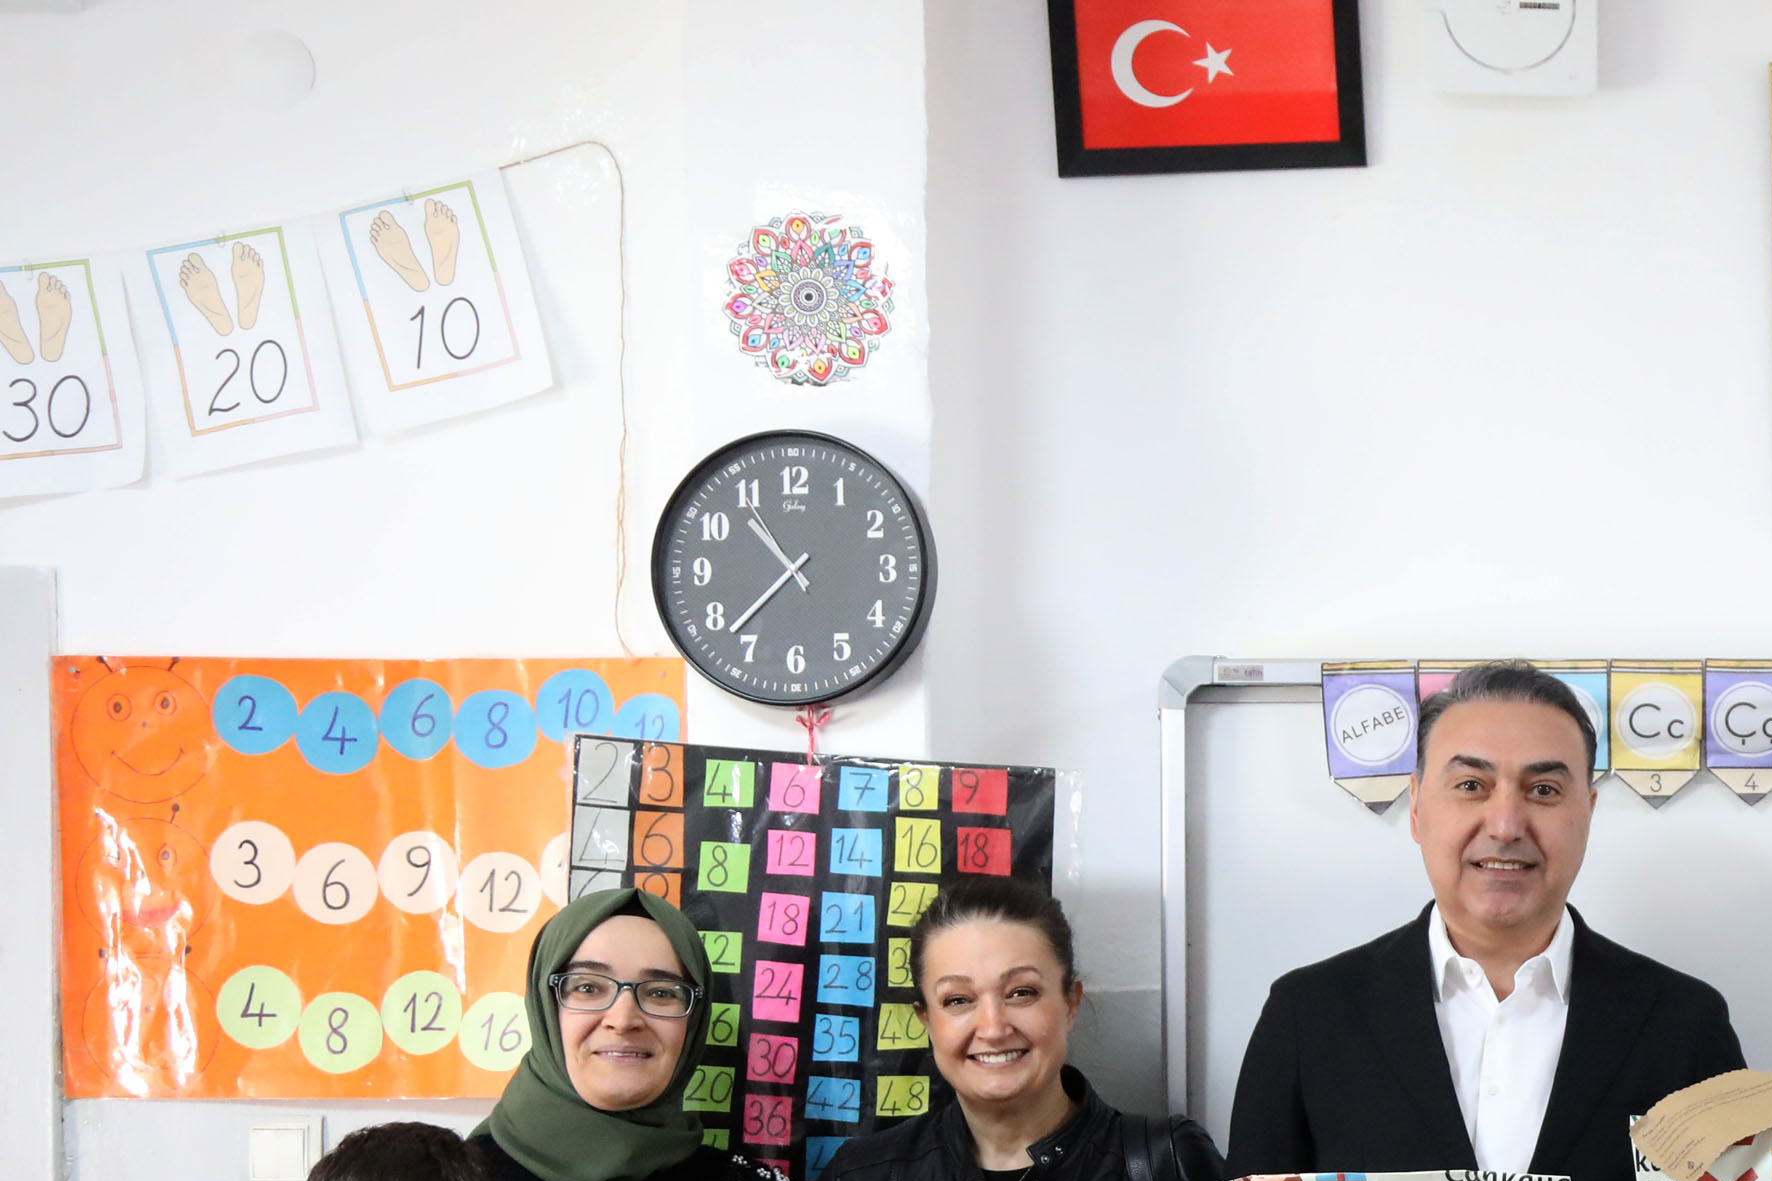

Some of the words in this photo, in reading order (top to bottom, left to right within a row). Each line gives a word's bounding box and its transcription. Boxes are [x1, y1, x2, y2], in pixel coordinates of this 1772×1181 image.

[408, 296, 480, 370] 10
[208, 339, 288, 416] 20
[2, 374, 91, 442] 30
[736, 479, 760, 508] 11
[780, 466, 809, 495] 12
[833, 478, 845, 506] 1
[700, 512, 730, 541] 10
[867, 510, 884, 538] 2
[693, 557, 712, 586] 9
[879, 554, 897, 583] 3
[705, 602, 725, 630] 8
[867, 600, 885, 627] 4
[740, 634, 758, 662] 7
[786, 645, 805, 673] 6
[833, 633, 851, 660] 5
[238, 695, 263, 733] 2
[322, 706, 358, 755] 4
[411, 693, 436, 738] 6
[485, 702, 509, 750] 8
[557, 687, 600, 729] 10
[1341, 706, 1406, 743] ALFABE
[1629, 703, 1685, 739] Cc
[582, 741, 619, 804] 2
[647, 742, 675, 803] 3
[706, 771, 733, 803] 4
[783, 775, 807, 808] 6
[852, 772, 876, 805] 7
[905, 769, 926, 808] 8
[960, 770, 980, 804] 9
[1650, 773, 1662, 793] 3
[1744, 773, 1758, 791] 4
[579, 808, 626, 865] 4
[641, 814, 674, 868] 6
[706, 844, 728, 887] 8
[775, 835, 810, 868] 12
[837, 834, 872, 866] 14
[901, 824, 939, 868] 16
[960, 835, 990, 868] 18
[234, 839, 262, 889] 3
[323, 859, 351, 911] 6
[407, 845, 432, 898] 9
[480, 869, 529, 914] 12
[764, 902, 798, 935] 18
[825, 906, 865, 934] 21
[755, 967, 797, 1005] 24
[824, 960, 873, 991] 28
[889, 947, 914, 985] 3
[241, 983, 277, 1027] 4
[326, 1007, 350, 1055] 8
[403, 991, 445, 1035] 12
[481, 1012, 523, 1054] 16
[685, 1068, 733, 1104] 20
[752, 1038, 795, 1078] 30
[814, 1017, 856, 1053] 35
[880, 1010, 927, 1044] 40
[744, 1100, 787, 1136] 36
[807, 1080, 860, 1111] 42
[881, 1082, 924, 1116] 48
